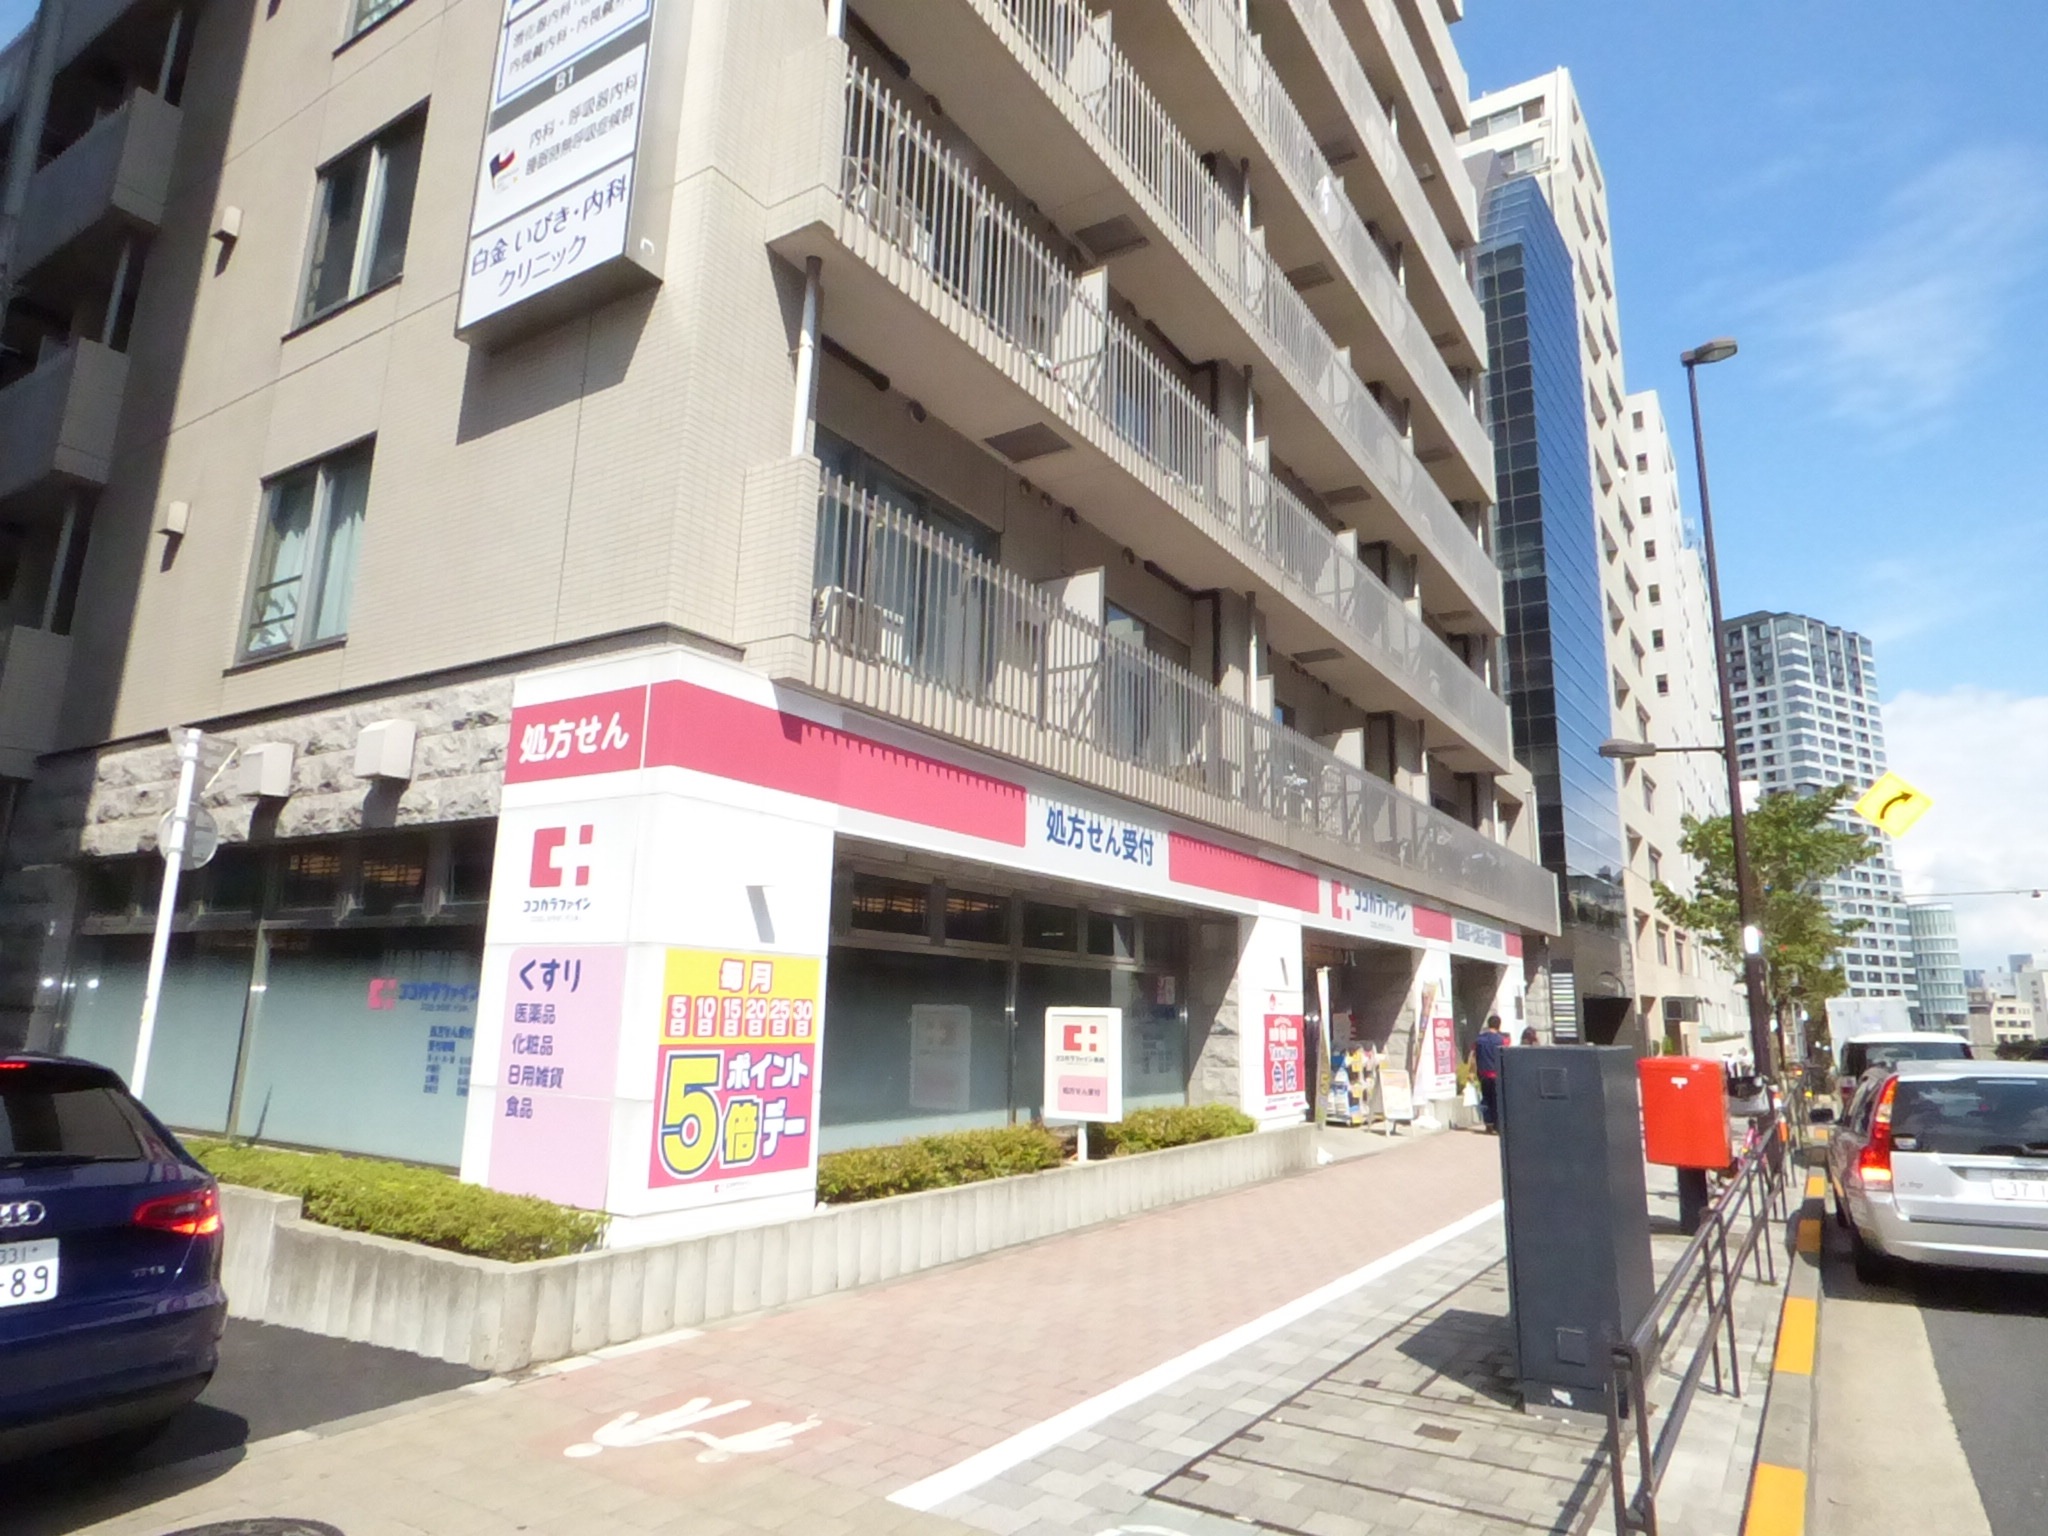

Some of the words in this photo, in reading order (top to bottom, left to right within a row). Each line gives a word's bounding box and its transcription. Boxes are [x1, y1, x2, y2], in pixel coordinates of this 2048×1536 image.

[555, 66, 575, 92] B1
[498, 235, 587, 297] クリニック
[519, 712, 630, 764] 処方せん
[1046, 806, 1154, 866] 処方せん受付
[523, 897, 591, 912] ココカラファイン
[519, 959, 581, 992] くすり
[515, 1003, 556, 1024] 医薬品
[512, 1033, 553, 1056] 化粧品
[508, 1064, 564, 1089] 日用雑貨
[726, 1052, 809, 1091] ポイント
[505, 1095, 533, 1119] 食品
